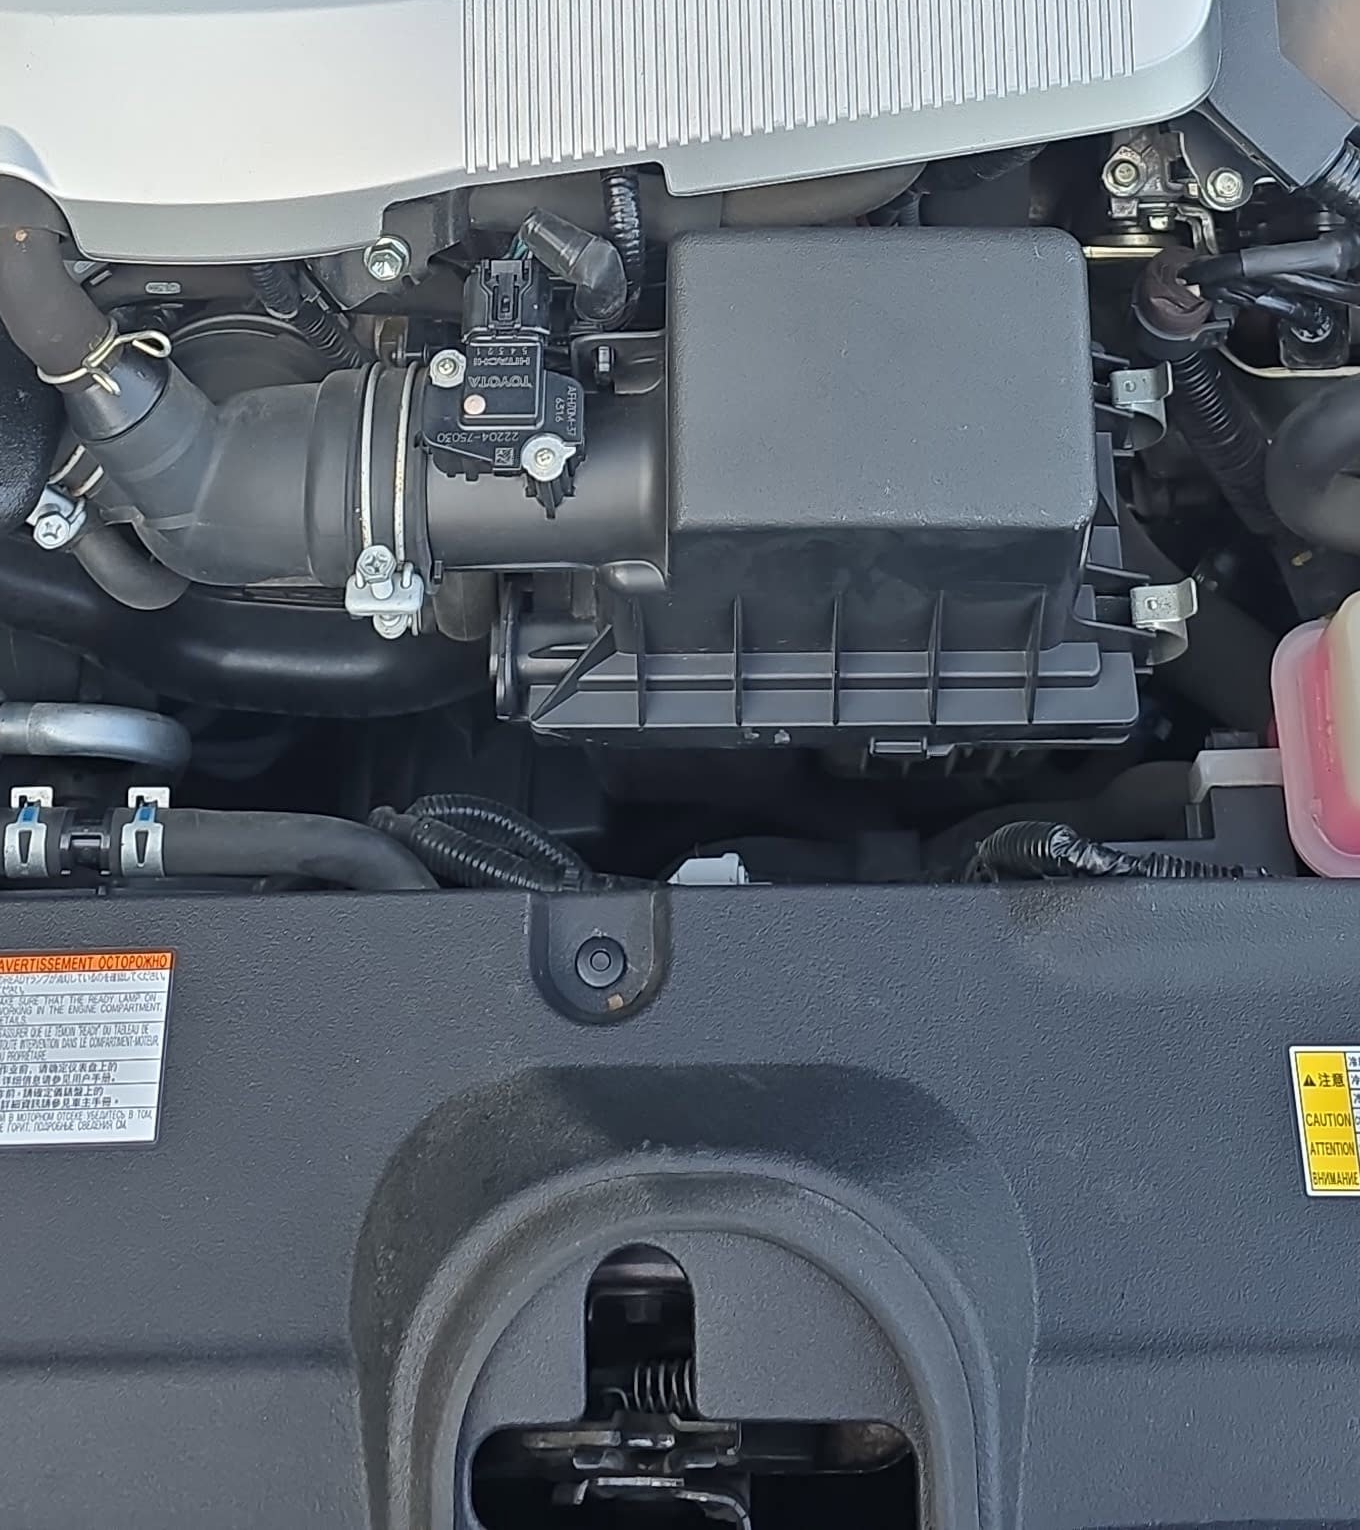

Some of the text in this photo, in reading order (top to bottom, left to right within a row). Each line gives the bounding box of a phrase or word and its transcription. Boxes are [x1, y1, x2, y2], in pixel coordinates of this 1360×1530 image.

[473, 357, 530, 366] HITACHI
[468, 375, 533, 388] TOYOTA
[436, 432, 519, 443] 22204-75030
[1317, 1072, 1345, 1087] 注意
[1305, 1113, 1351, 1126] CAUTION
[1309, 1141, 1355, 1156] ATTENTION
[1312, 1171, 1359, 1186] ВНИМАНИЕ
